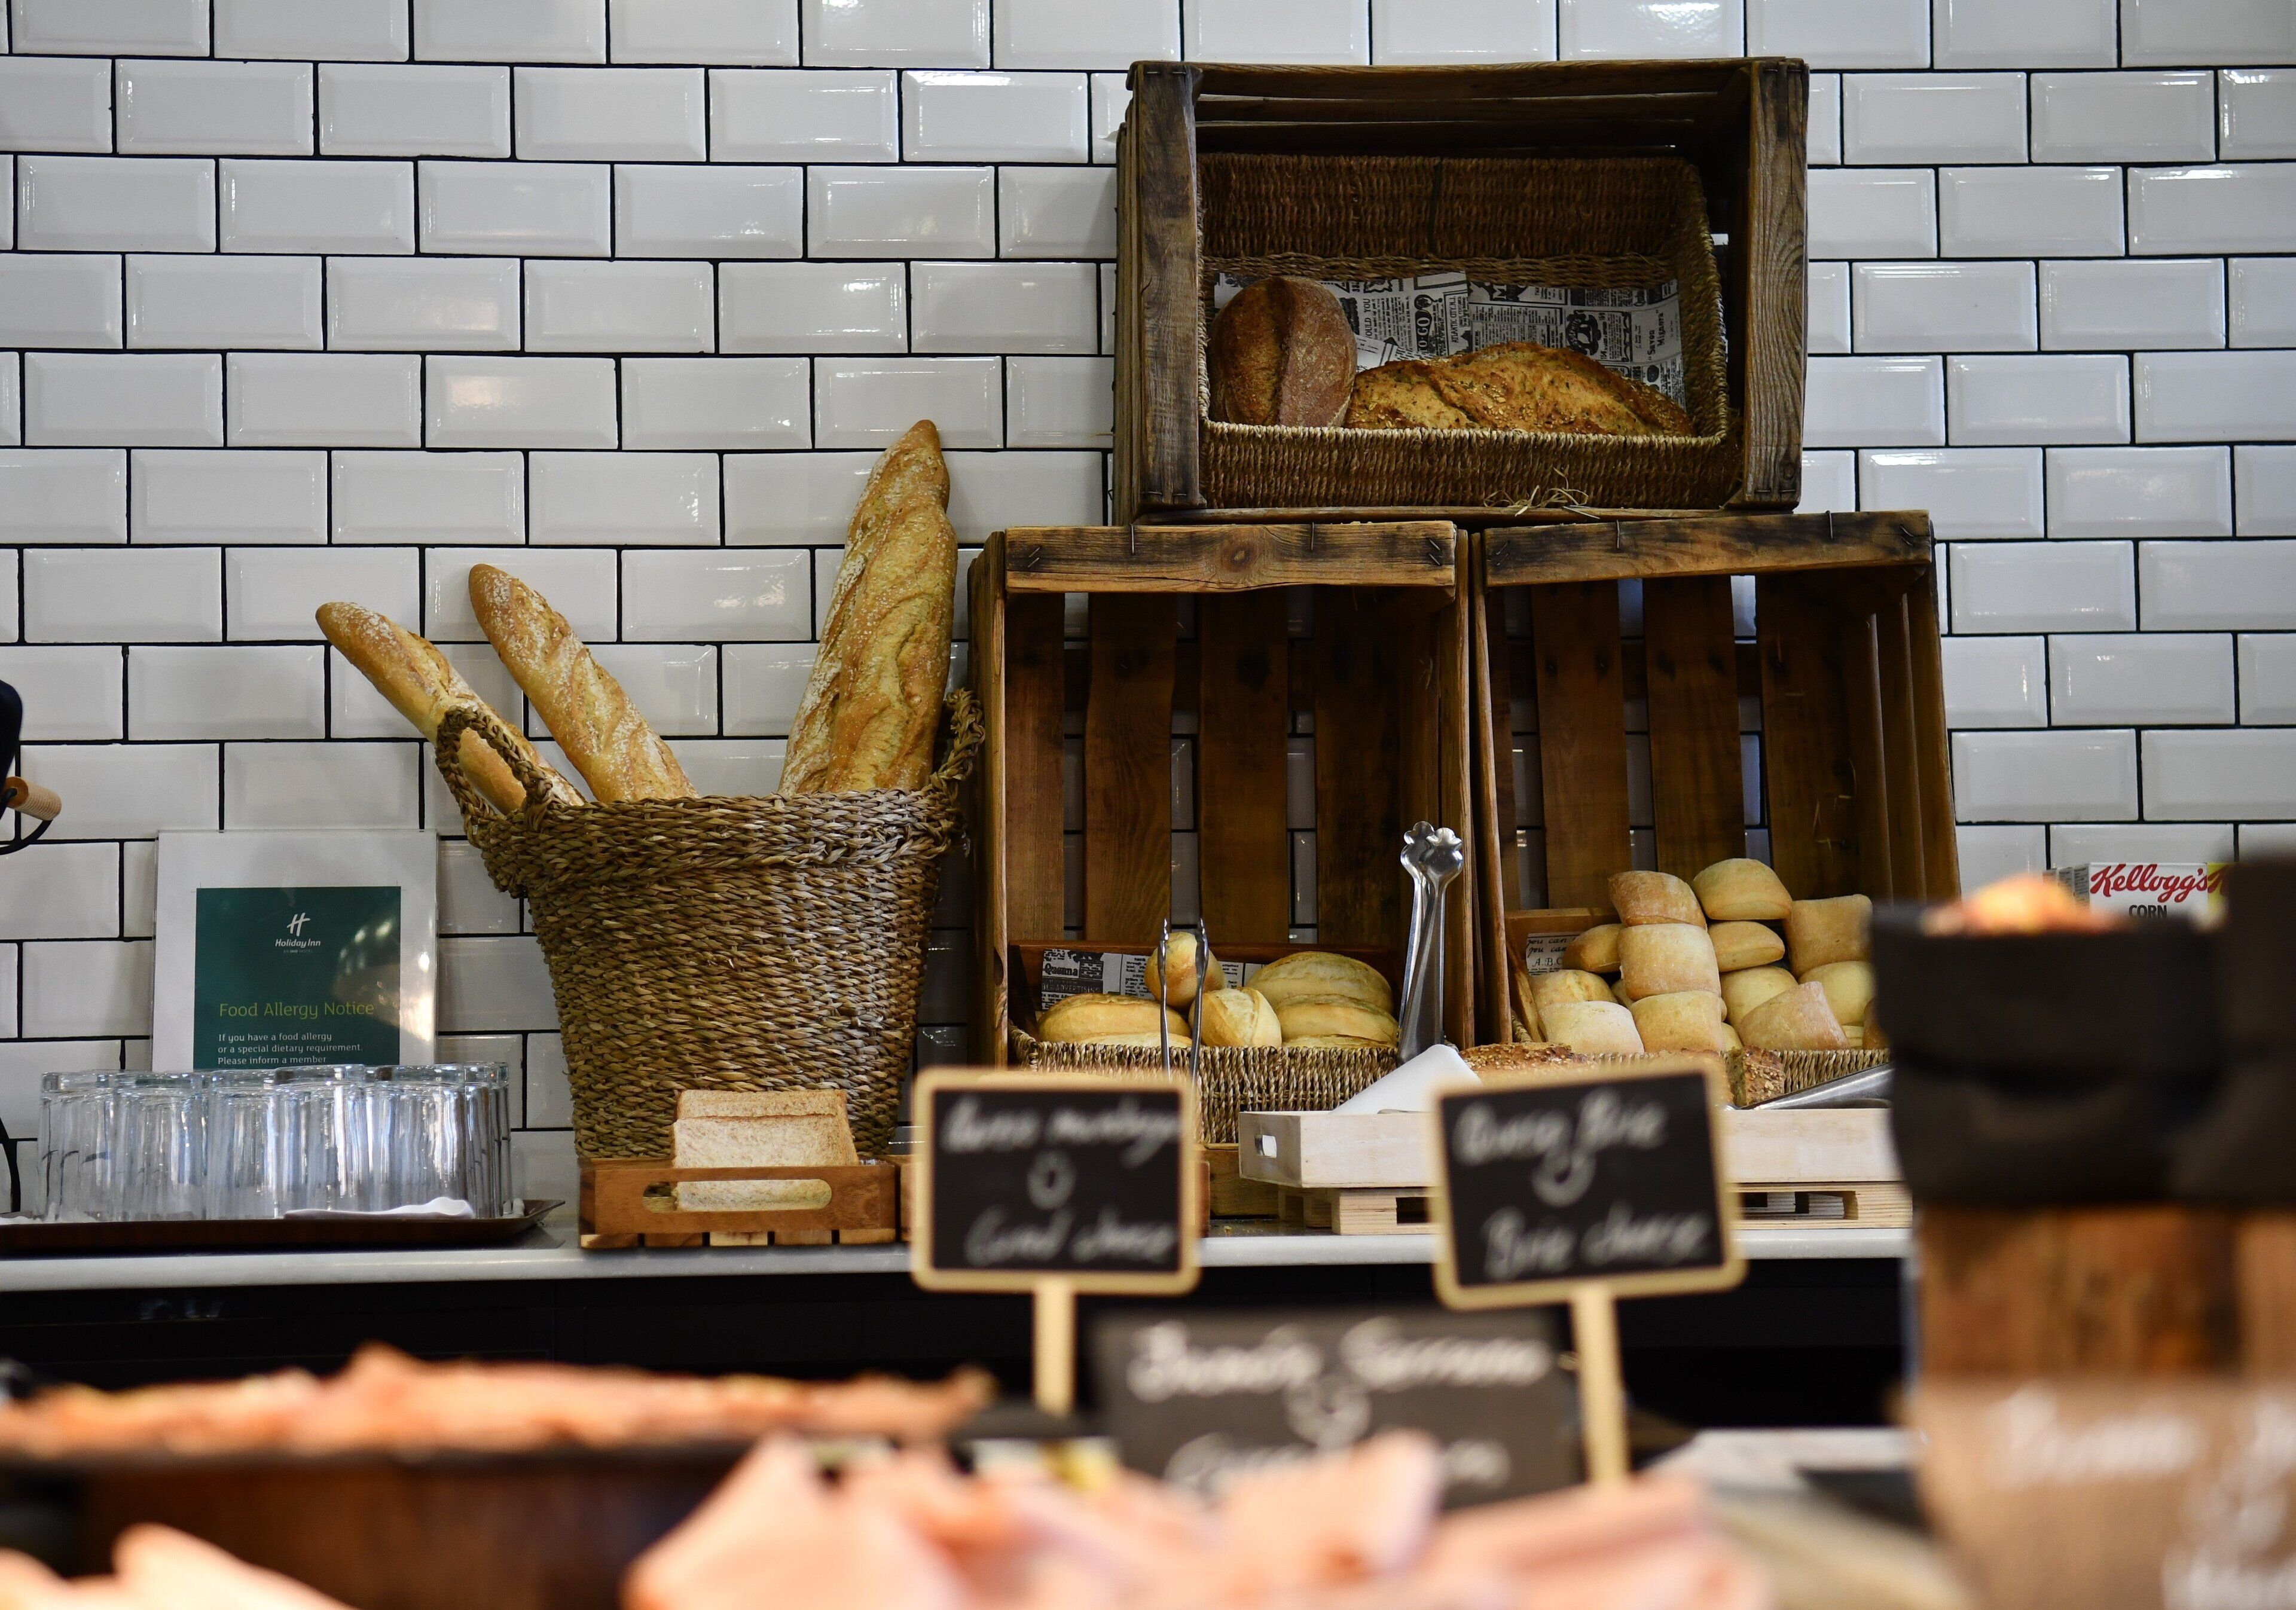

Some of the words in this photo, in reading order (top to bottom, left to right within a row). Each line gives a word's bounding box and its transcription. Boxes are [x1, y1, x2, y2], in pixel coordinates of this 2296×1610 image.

[1363, 298, 1372, 313] YOU
[2090, 863, 2208, 903] Kellogg's
[2129, 905, 2168, 919] CORN
[275, 938, 307, 949] Holiday
[307, 938, 321, 946] Inn
[219, 1002, 258, 1017] Food
[263, 1002, 319, 1020] Allergy
[323, 1001, 375, 1016] Notice
[218, 1033, 227, 1041] If
[228, 1035, 245, 1043] you
[248, 1033, 269, 1041] have
[279, 1032, 299, 1041] food
[301, 1032, 332, 1042] allergy
[237, 1044, 269, 1055] special
[271, 1044, 304, 1054] dietary
[218, 1056, 248, 1065] Please
[249, 1056, 279, 1065] inform
[289, 1055, 326, 1064] member
